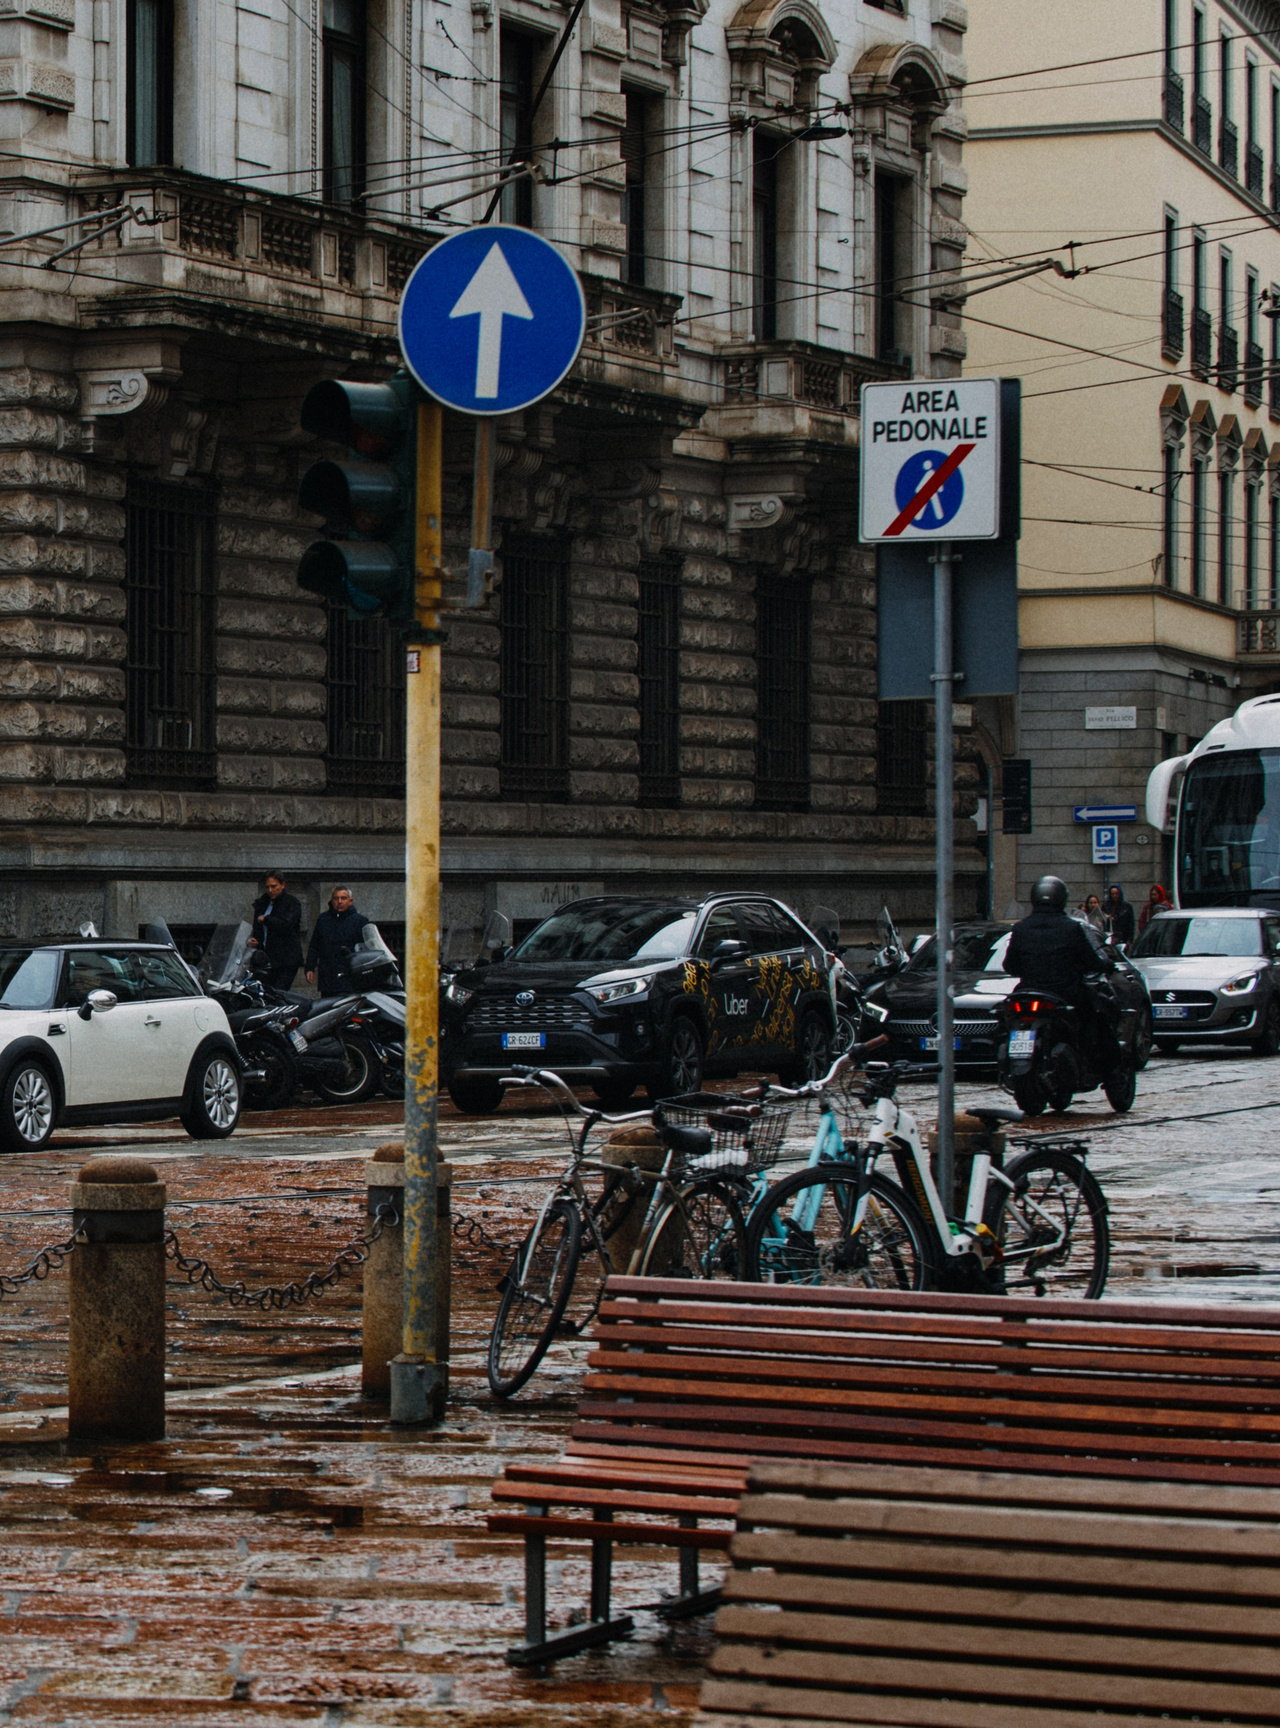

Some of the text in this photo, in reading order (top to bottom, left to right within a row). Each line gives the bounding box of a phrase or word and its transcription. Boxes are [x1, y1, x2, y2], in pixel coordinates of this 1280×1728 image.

[901, 389, 959, 414] AREA
[873, 416, 988, 443] PEDONALE
[1100, 831, 1112, 845] P
[724, 993, 749, 1015] Uber
